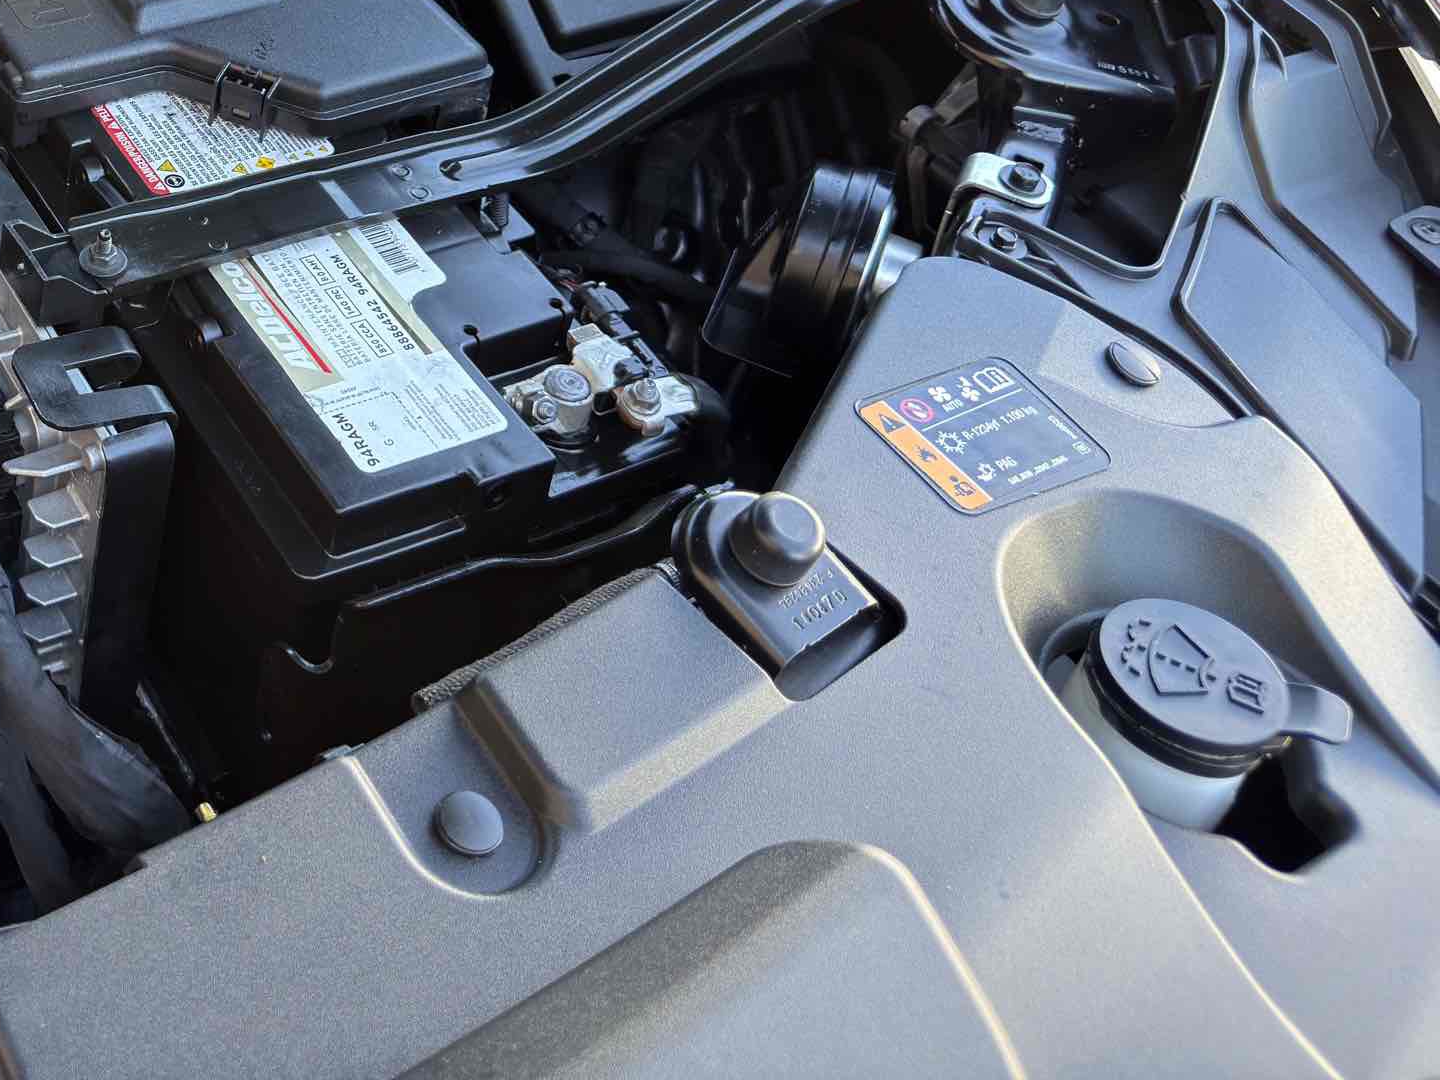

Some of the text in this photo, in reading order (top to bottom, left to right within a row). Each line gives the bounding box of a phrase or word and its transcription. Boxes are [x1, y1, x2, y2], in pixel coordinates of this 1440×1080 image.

[329, 253, 369, 295] 94RAGM
[220, 261, 314, 370] ACDelco
[339, 300, 356, 315] 140
[357, 322, 375, 338] CCA
[365, 298, 415, 351] 88864542
[942, 400, 963, 413] AUTO
[330, 411, 381, 467] 94RAGM
[996, 456, 1017, 472] PAG
